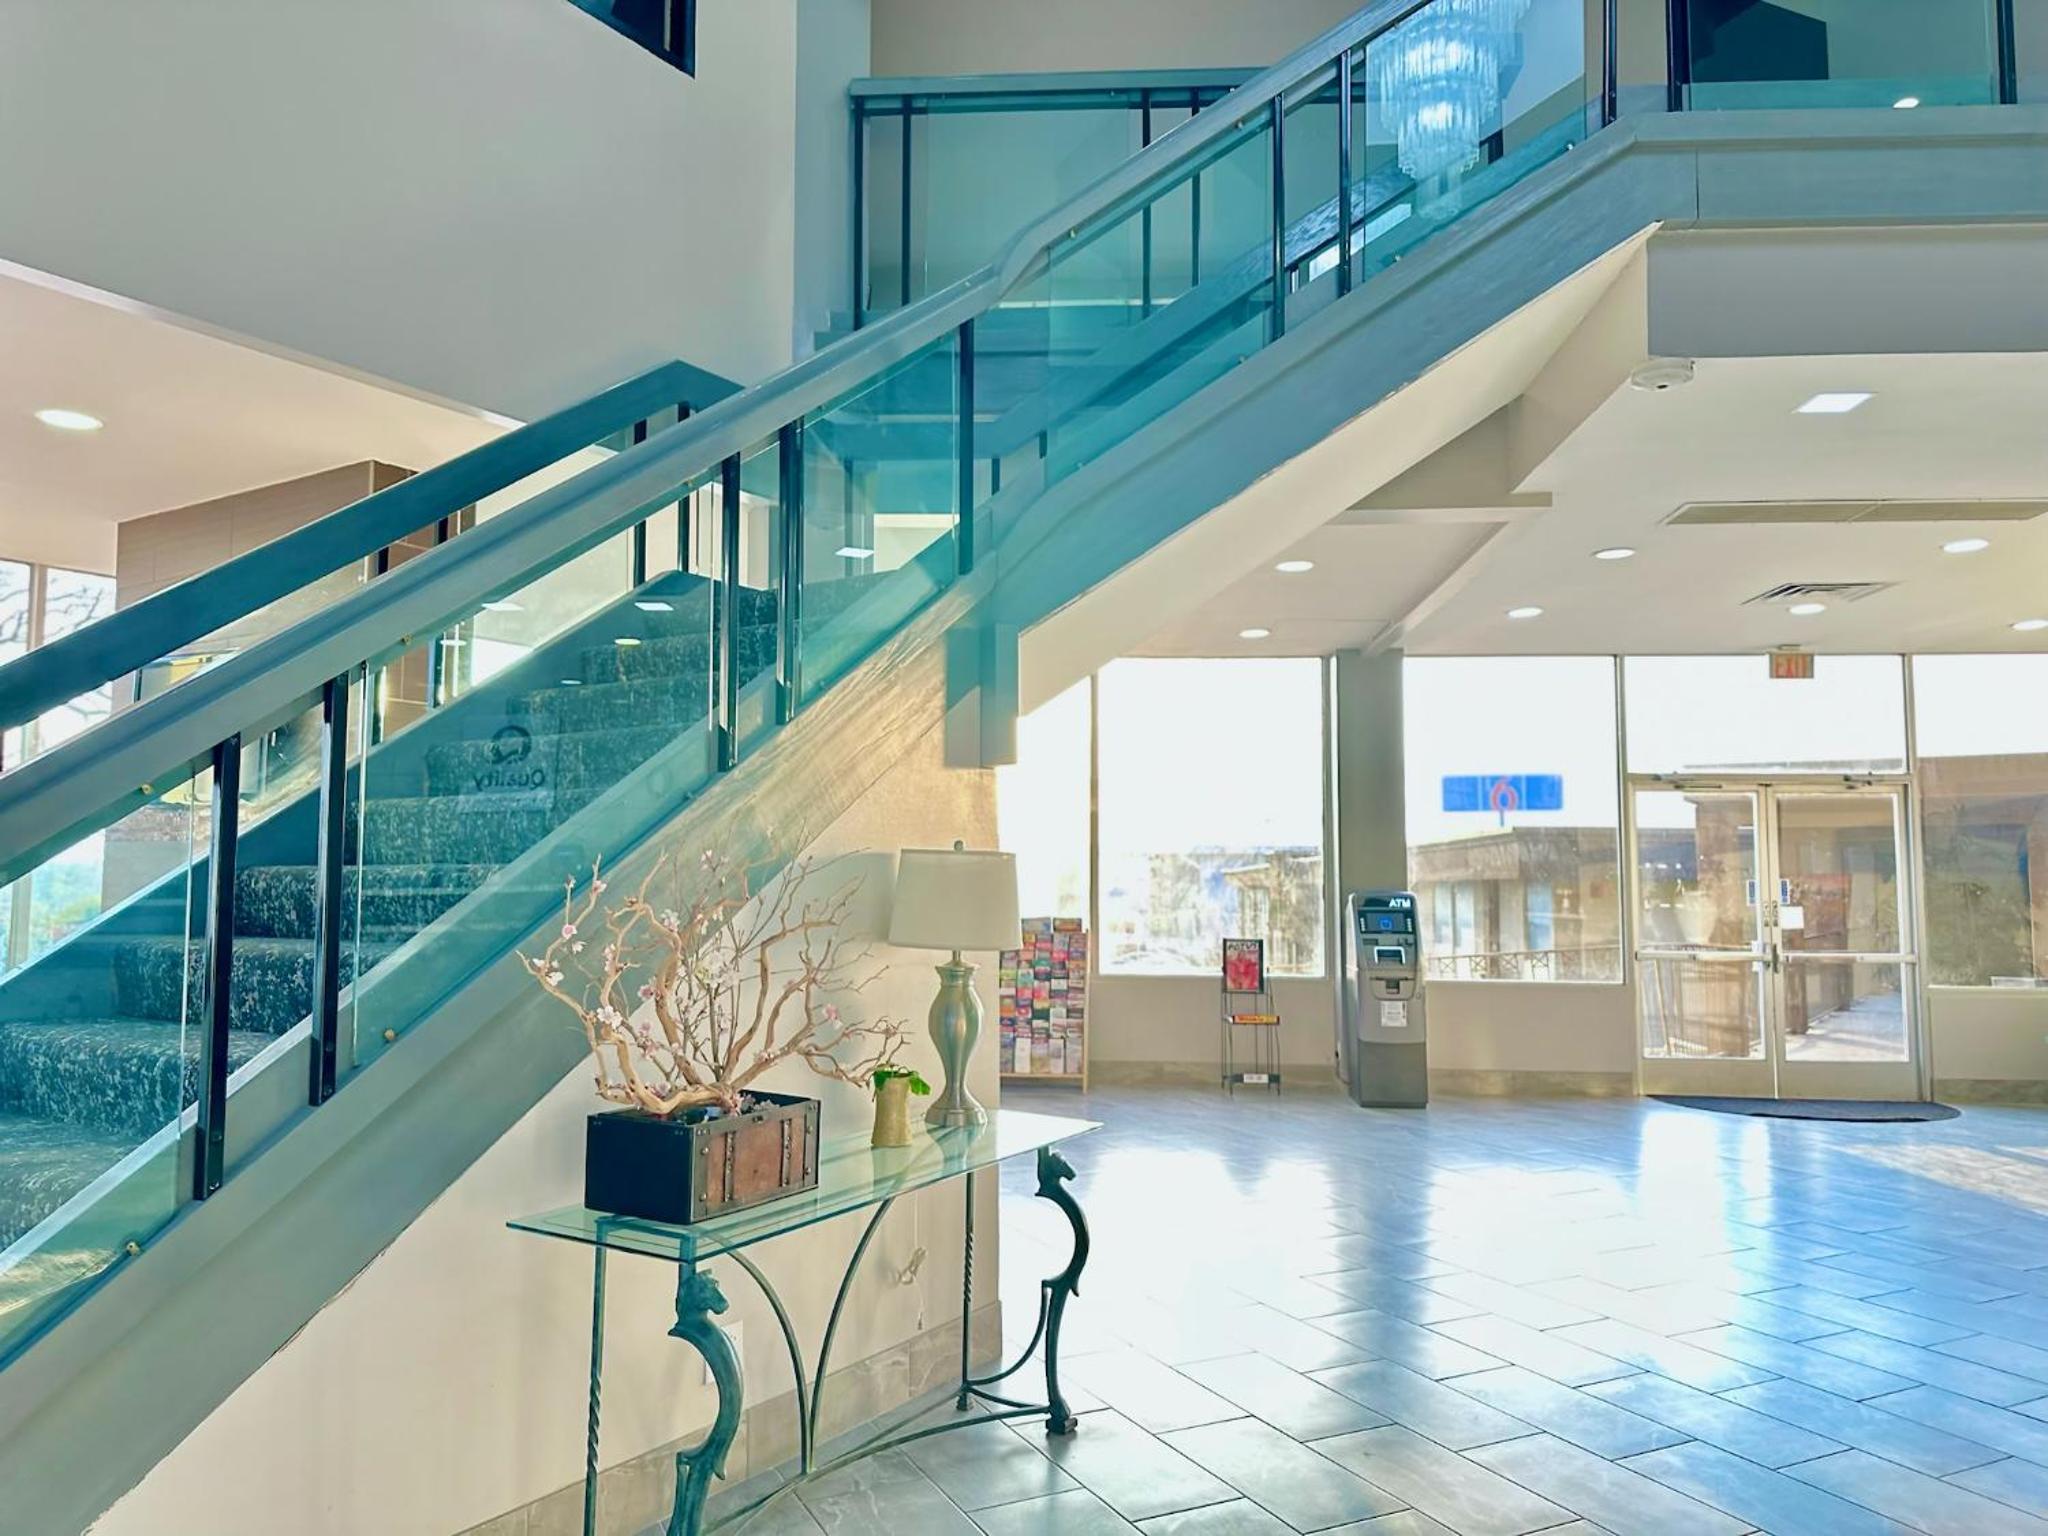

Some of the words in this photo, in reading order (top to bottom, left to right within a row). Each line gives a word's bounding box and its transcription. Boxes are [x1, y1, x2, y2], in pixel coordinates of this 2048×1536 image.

[1775, 655, 1809, 678] EXIT
[1490, 776, 1518, 811] 6
[1389, 898, 1411, 908] ATM
